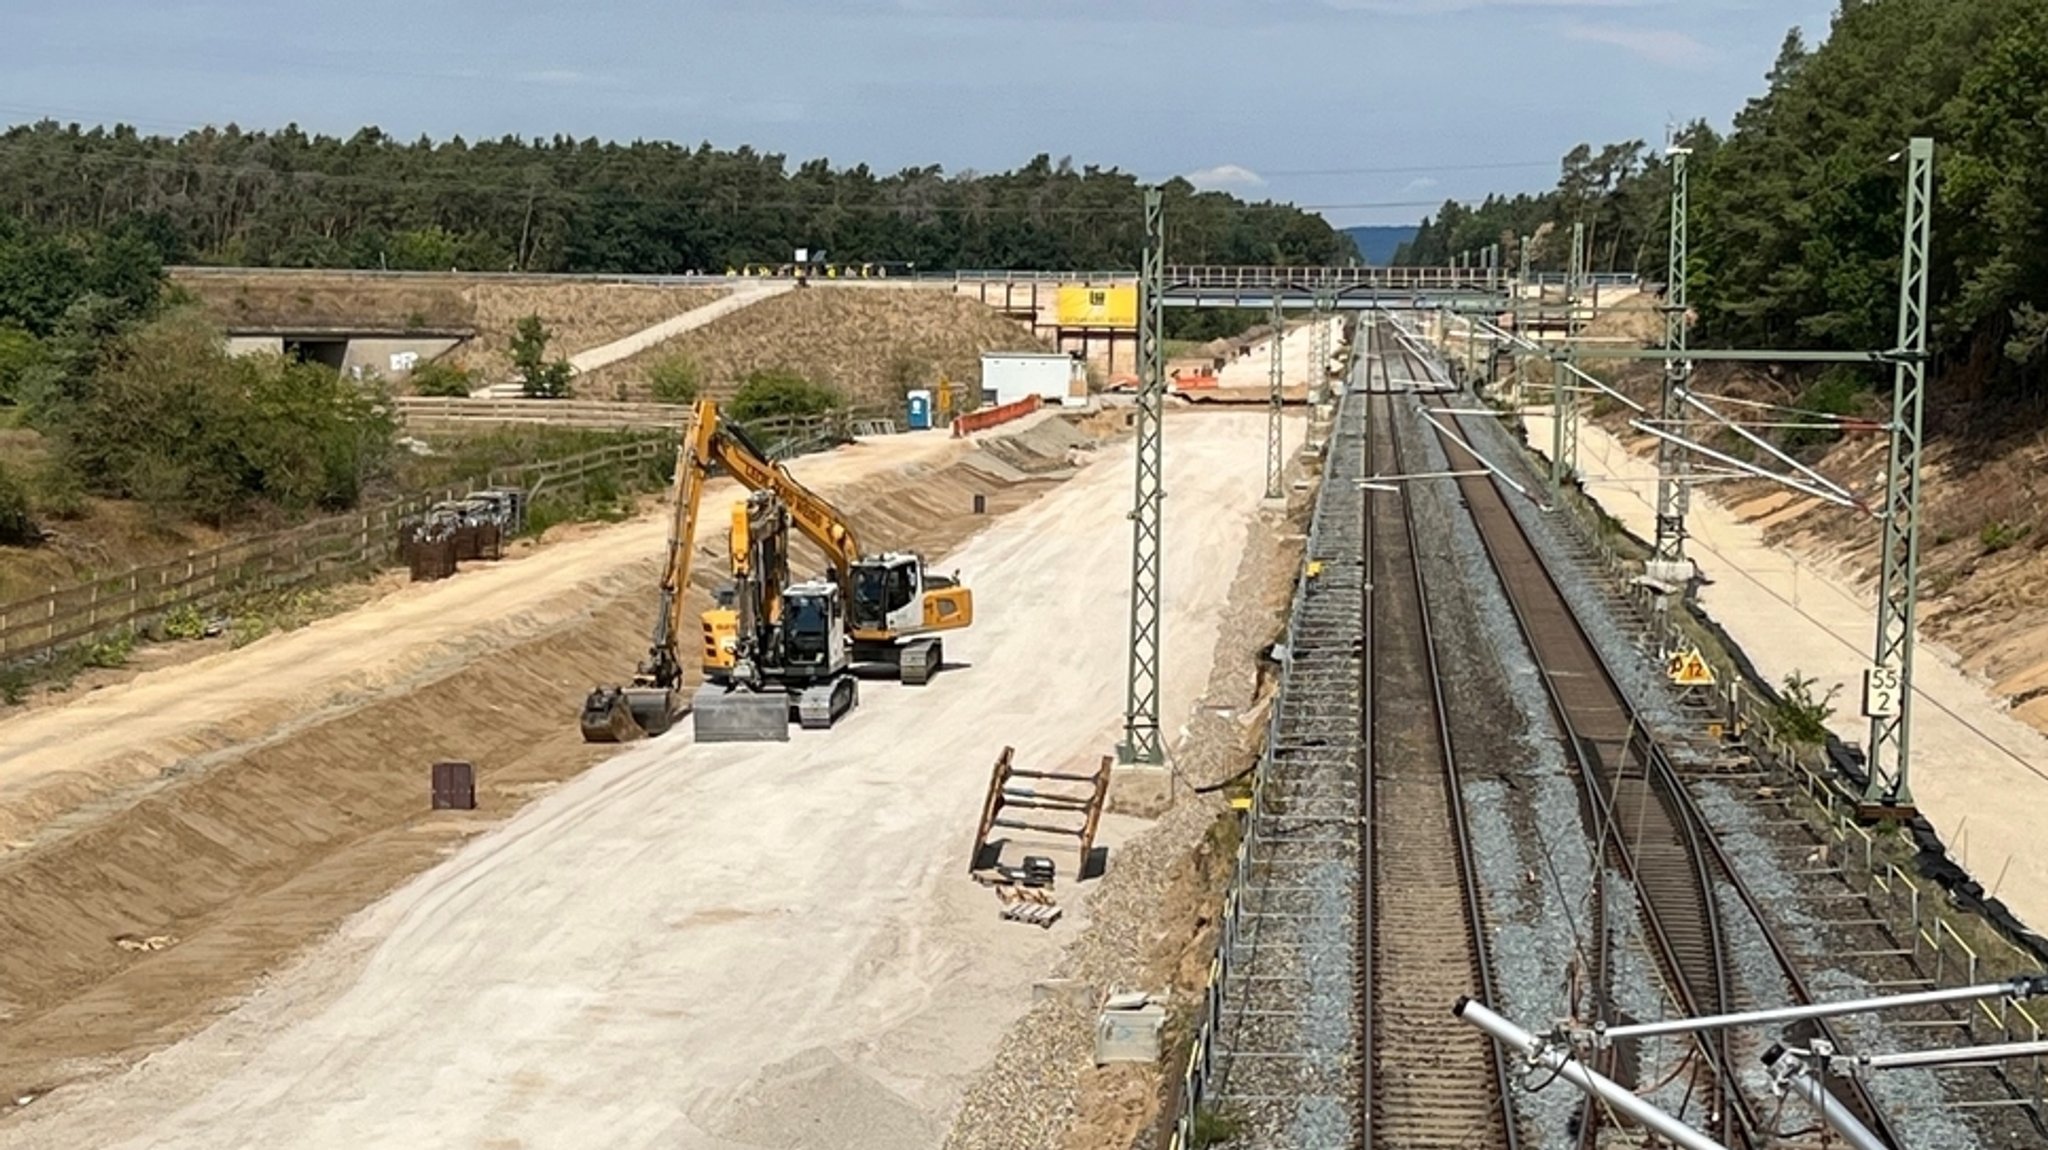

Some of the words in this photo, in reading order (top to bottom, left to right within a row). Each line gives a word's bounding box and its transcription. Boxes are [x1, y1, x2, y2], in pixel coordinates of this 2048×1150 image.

[1688, 662, 1703, 677] 12
[1872, 669, 1897, 689] 55
[1877, 691, 1891, 711] 2
